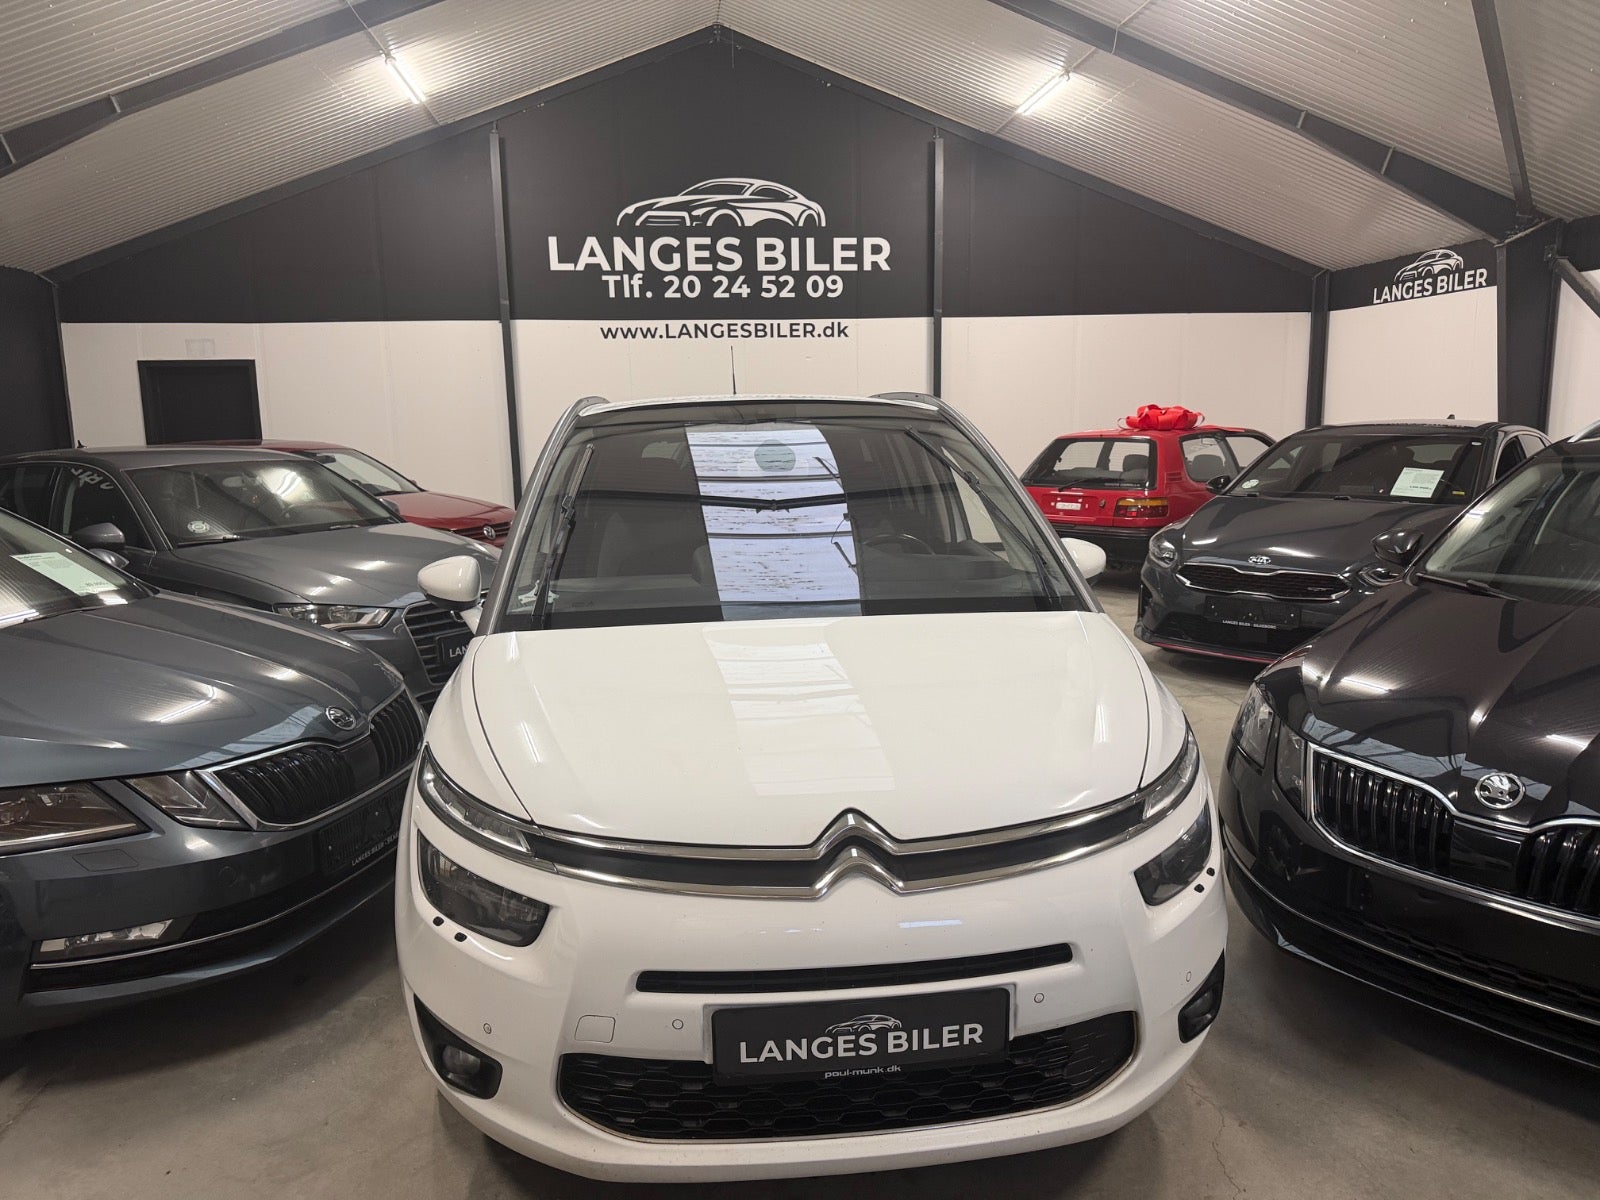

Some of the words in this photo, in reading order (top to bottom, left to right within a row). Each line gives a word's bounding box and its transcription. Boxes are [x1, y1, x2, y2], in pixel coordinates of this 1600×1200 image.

[548, 235, 743, 272] LANGES
[756, 237, 891, 272] BILER
[602, 273, 653, 298] Tlf.
[663, 275, 702, 298] 20
[712, 275, 751, 298] 24
[760, 275, 796, 298] 52
[806, 275, 844, 298] 09
[1373, 277, 1433, 304] LANGES
[1436, 268, 1488, 294] BILER
[600, 321, 849, 340] www.LANGESBILER.dk
[740, 1034, 878, 1063] LANGES
[886, 1023, 984, 1053] BILER
